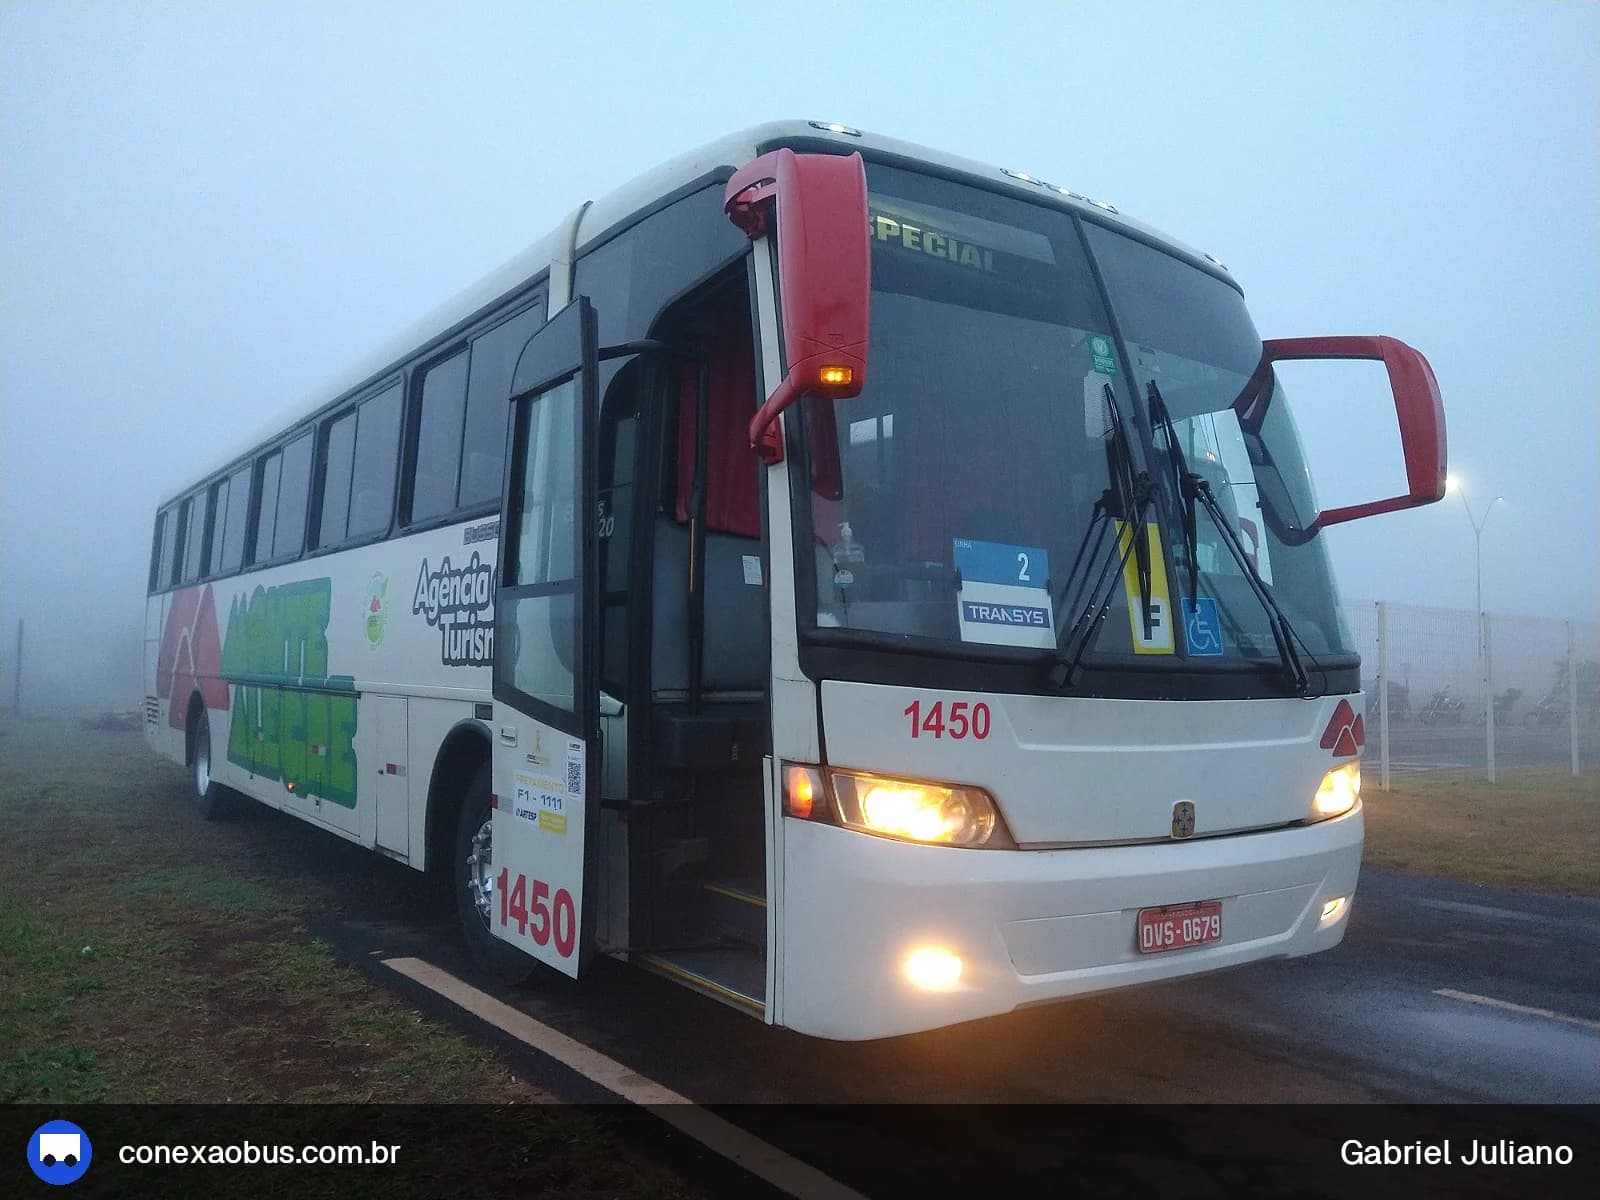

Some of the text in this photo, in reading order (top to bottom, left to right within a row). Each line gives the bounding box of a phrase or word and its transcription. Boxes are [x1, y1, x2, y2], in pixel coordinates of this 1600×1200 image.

[1017, 552, 1031, 581] 2
[413, 551, 491, 625] Agência
[968, 605, 1044, 624] TRANSYS
[1143, 603, 1161, 641] F
[904, 699, 991, 740] 1450
[496, 866, 576, 958] 1450
[1143, 915, 1220, 948] DVS-0679
